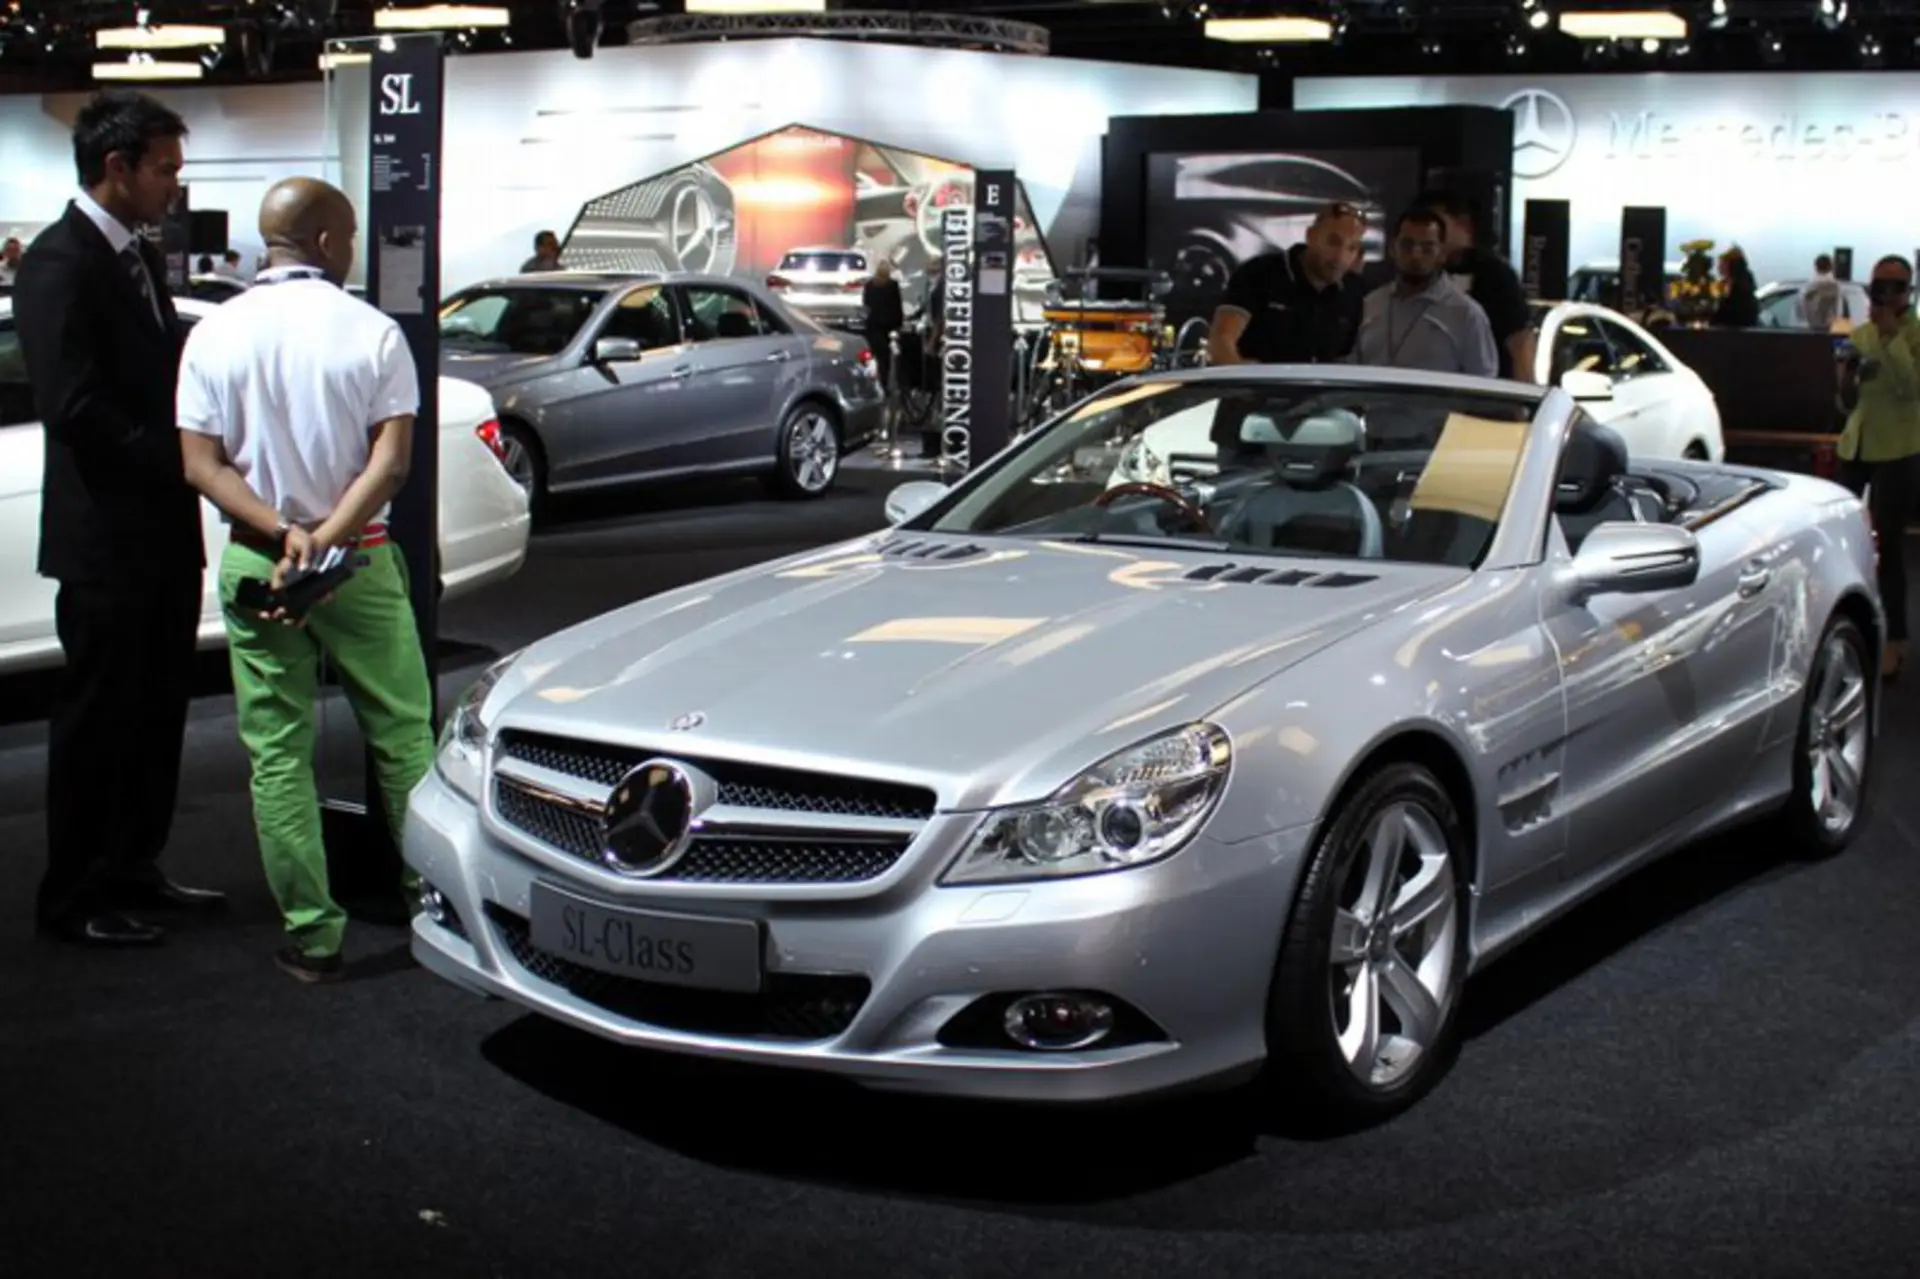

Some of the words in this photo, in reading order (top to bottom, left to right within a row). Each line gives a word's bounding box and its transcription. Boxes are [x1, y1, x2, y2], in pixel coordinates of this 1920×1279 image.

[380, 73, 421, 115] SL
[1603, 110, 1920, 160] Meedes-B
[986, 184, 1000, 206] E
[562, 905, 696, 975] SL-Class
